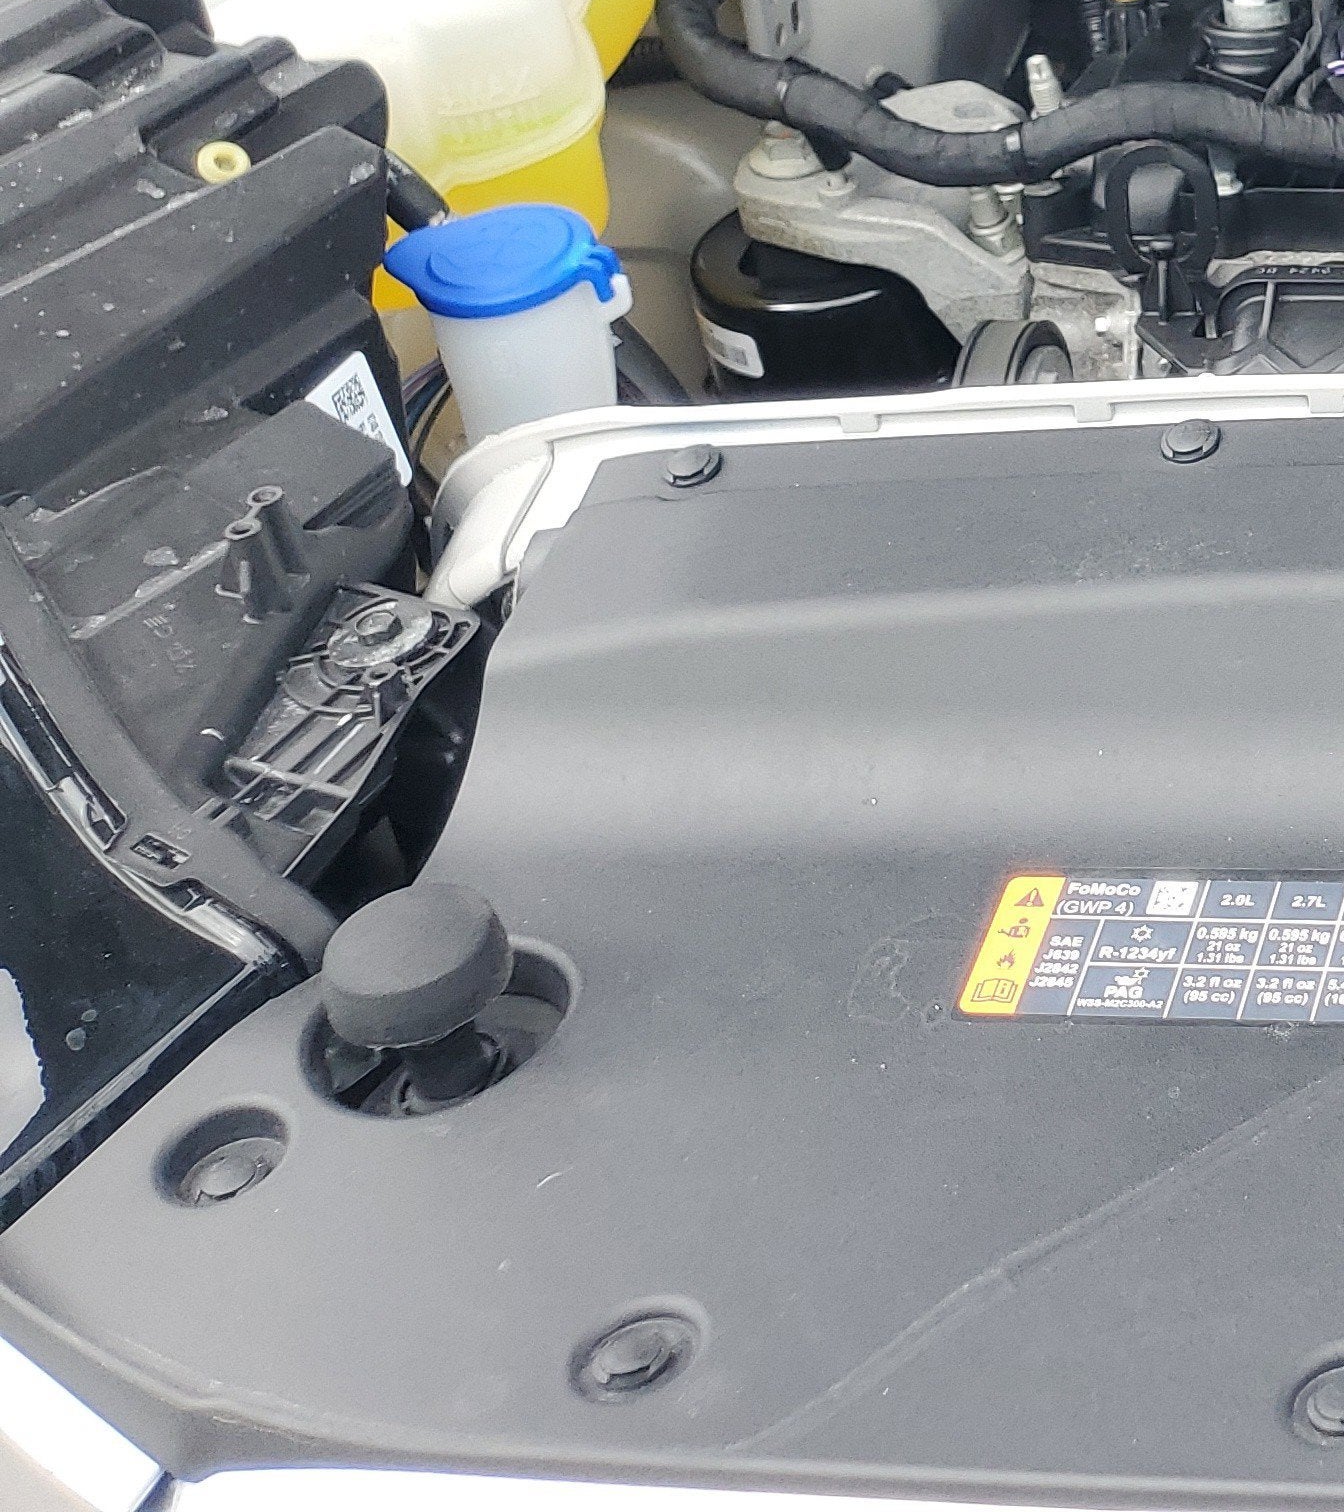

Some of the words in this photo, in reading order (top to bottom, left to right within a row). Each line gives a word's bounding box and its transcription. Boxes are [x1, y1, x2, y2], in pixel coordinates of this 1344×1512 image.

[1067, 882, 1142, 897] FoMoCo
[1220, 894, 1255, 906] 2.0L
[1291, 895, 1326, 908] 2.7L
[1056, 900, 1113, 916] (GWP
[1114, 901, 1134, 917] 4)
[1049, 935, 1084, 947] SAE
[1196, 926, 1238, 940] 0.595
[1239, 928, 1259, 944] kg
[1268, 928, 1309, 942] 0.595
[1311, 929, 1331, 945] kg
[1206, 941, 1223, 951] 21
[1224, 943, 1242, 952] oz
[1278, 942, 1294, 953] 21
[1296, 944, 1314, 954] oz
[1099, 946, 1177, 962] R-1234yf
[1269, 954, 1294, 965] 1.31
[1182, 975, 1207, 988] 3.2
[1208, 976, 1221, 988] fl
[1222, 979, 1243, 989] oz
[1256, 977, 1280, 990] 3.2
[1282, 978, 1294, 990] fl
[1296, 980, 1316, 990] oz
[1103, 986, 1144, 999] PAG
[1183, 990, 1209, 1004] (95
[1210, 990, 1236, 1005] cc)
[1256, 992, 1282, 1006] (95
[1284, 993, 1309, 1007] cc)
